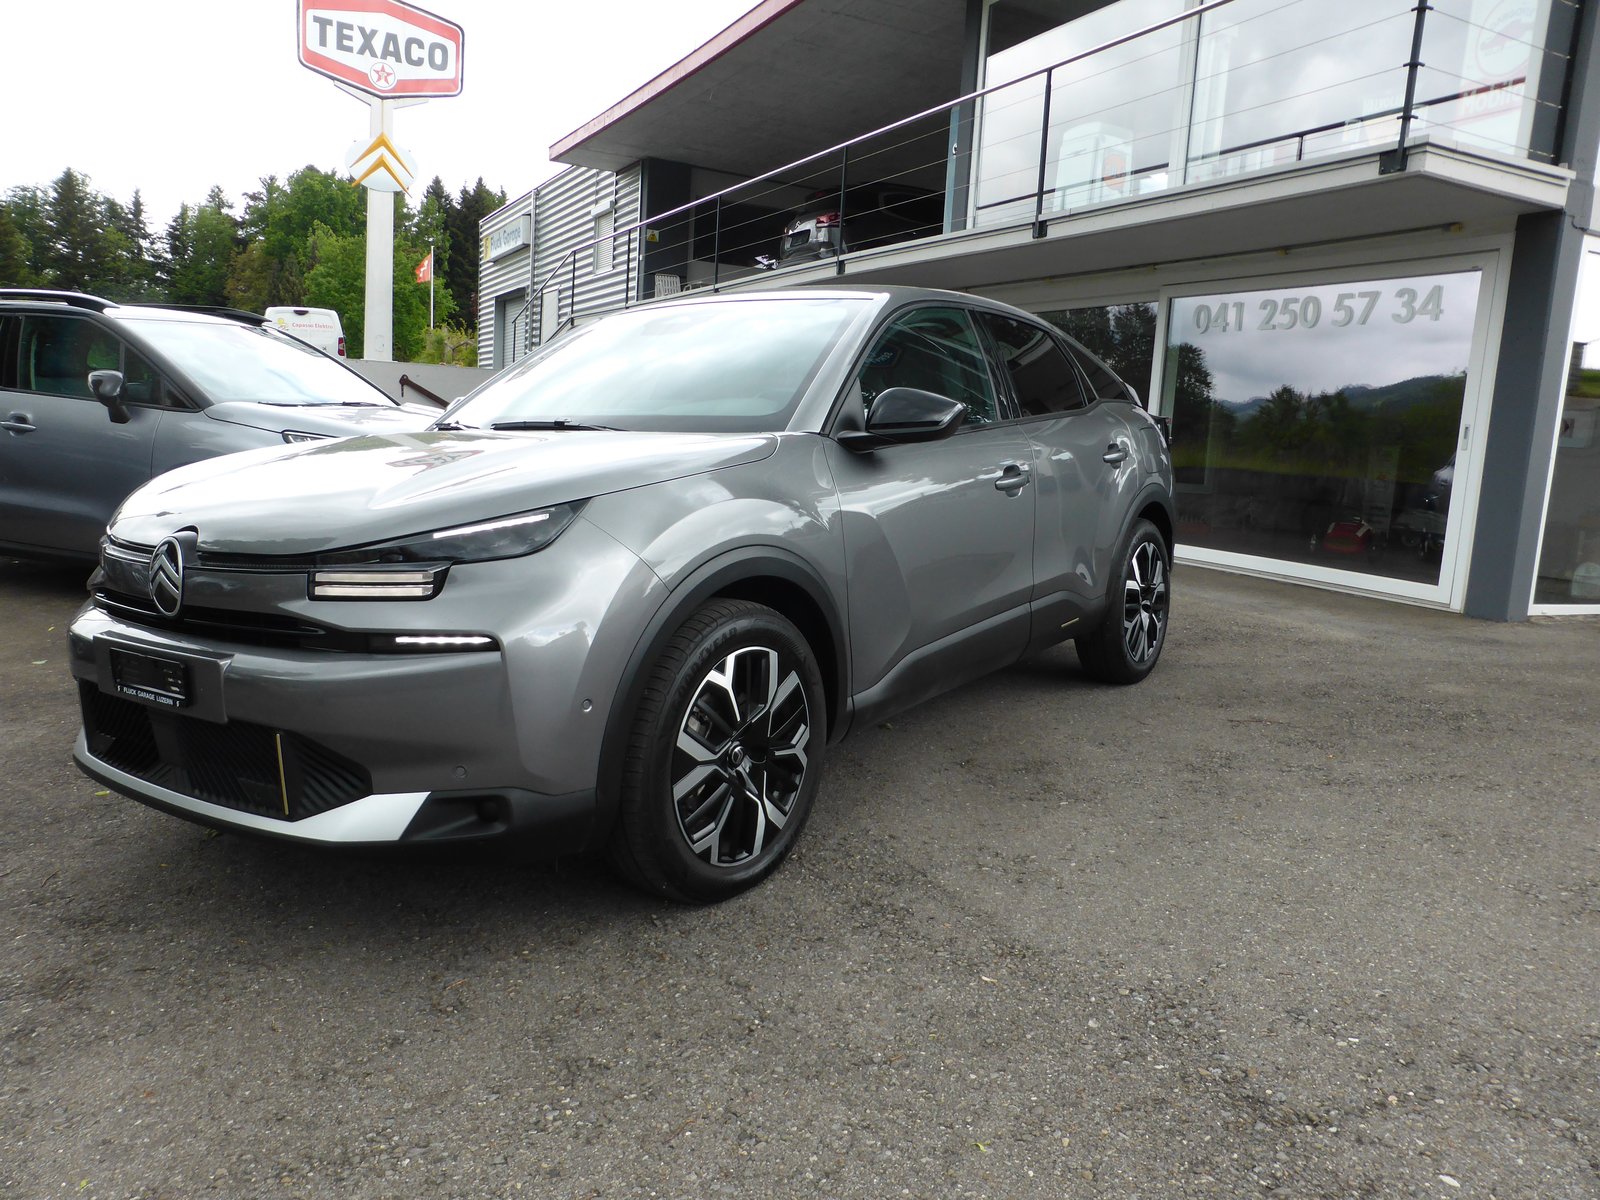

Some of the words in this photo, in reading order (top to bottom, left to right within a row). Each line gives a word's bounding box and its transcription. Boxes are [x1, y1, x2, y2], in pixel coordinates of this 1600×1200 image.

[312, 14, 449, 72] TEXACO
[1193, 300, 1245, 335] 041
[1256, 295, 1322, 331] 250
[1330, 289, 1382, 328] 57
[1391, 284, 1445, 325] 34
[123, 686, 137, 696] FLUCK
[137, 690, 156, 701] GARAGE
[156, 695, 173, 706] LUZERN
